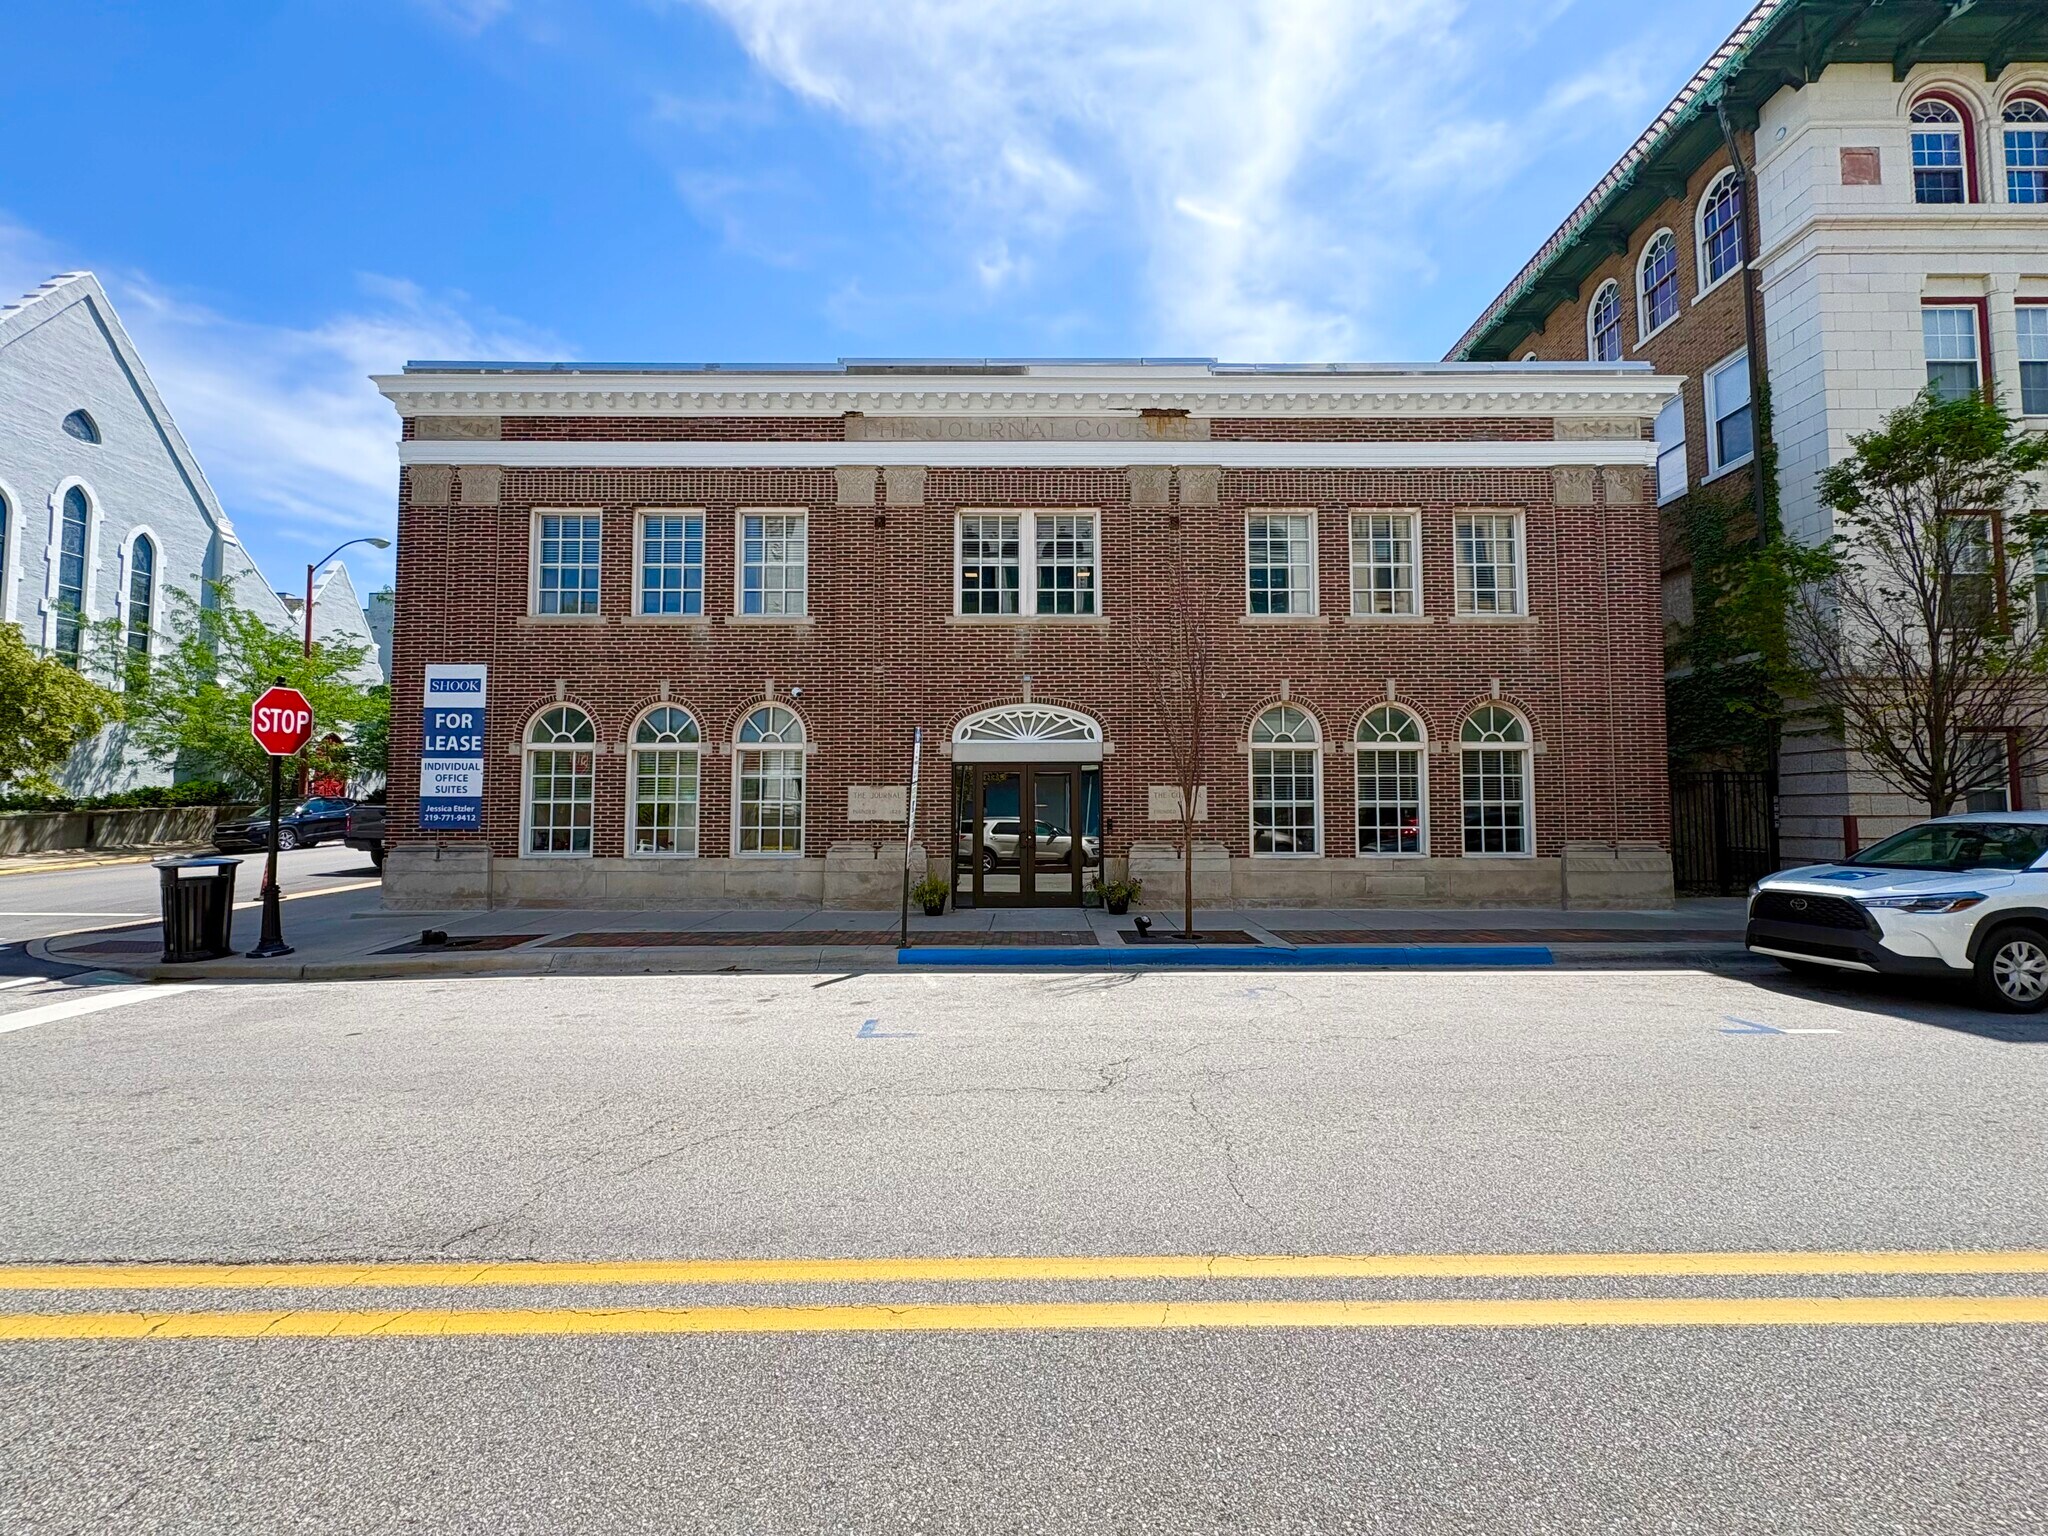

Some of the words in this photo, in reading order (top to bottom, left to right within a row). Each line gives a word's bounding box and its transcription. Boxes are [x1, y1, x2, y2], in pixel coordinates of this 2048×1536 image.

[925, 419, 1064, 439] JOURNAL
[1075, 419, 1200, 439] COURIER
[431, 680, 479, 691] SHOOK
[256, 706, 310, 734] STOP
[435, 713, 473, 729] FOR
[424, 735, 482, 751] LEASE
[424, 762, 481, 771] INDIVIDUAL
[434, 773, 469, 782] OFFICE
[434, 785, 468, 794] SUITES
[424, 814, 476, 822] 219-771-9412
